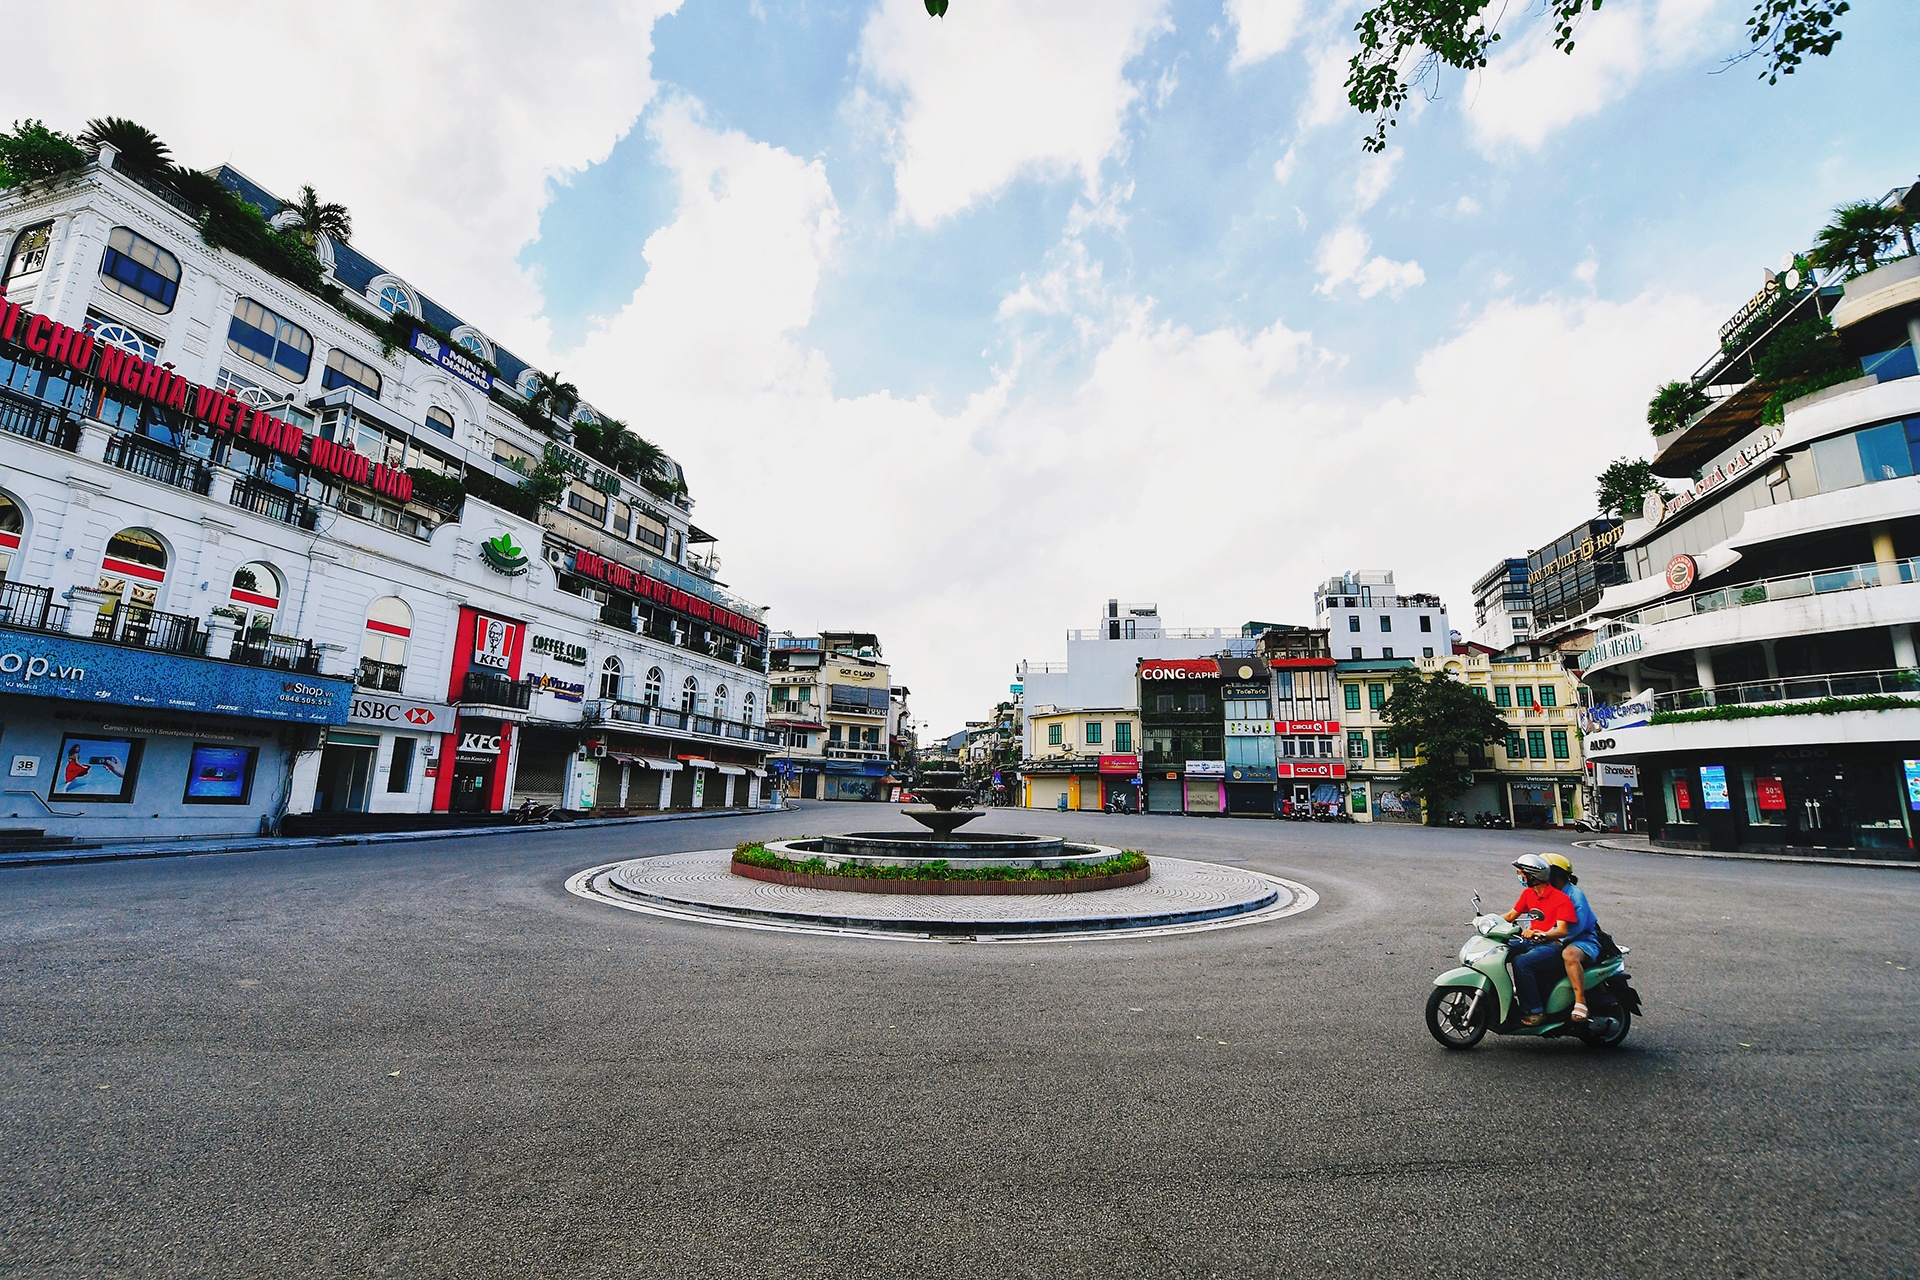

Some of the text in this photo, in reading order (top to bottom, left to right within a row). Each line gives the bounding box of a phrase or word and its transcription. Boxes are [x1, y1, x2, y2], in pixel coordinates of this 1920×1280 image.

[1718, 306, 1749, 338] AVALON
[441, 355, 490, 390] DIAMOND
[449, 349, 487, 379] MINH
[25, 321, 96, 370] CHỦ
[99, 361, 187, 411] NGHĨA
[196, 384, 252, 436] VIỆT
[250, 410, 304, 457] NAM
[310, 436, 369, 485] MUÔN
[373, 462, 413, 503] NĂM
[543, 441, 621, 497] COFFEE CLUB
[1528, 569, 1544, 585] MAY
[1555, 550, 1578, 571] VILLE
[532, 635, 565, 655] COFFEE
[479, 653, 505, 667] KFC
[1142, 666, 1220, 682] CỘNG CAPHE
[16, 682, 38, 690] Watch
[168, 699, 196, 707] SAMSUNG
[350, 700, 401, 721] HSBC
[1589, 702, 1616, 729] Tiger
[103, 724, 129, 732] Camera
[158, 729, 196, 740] Smartphone
[459, 733, 502, 751] KFC
[1590, 738, 1616, 751] ALDO
[18, 761, 33, 769] 3B
[1605, 765, 1634, 775] Sharetea
